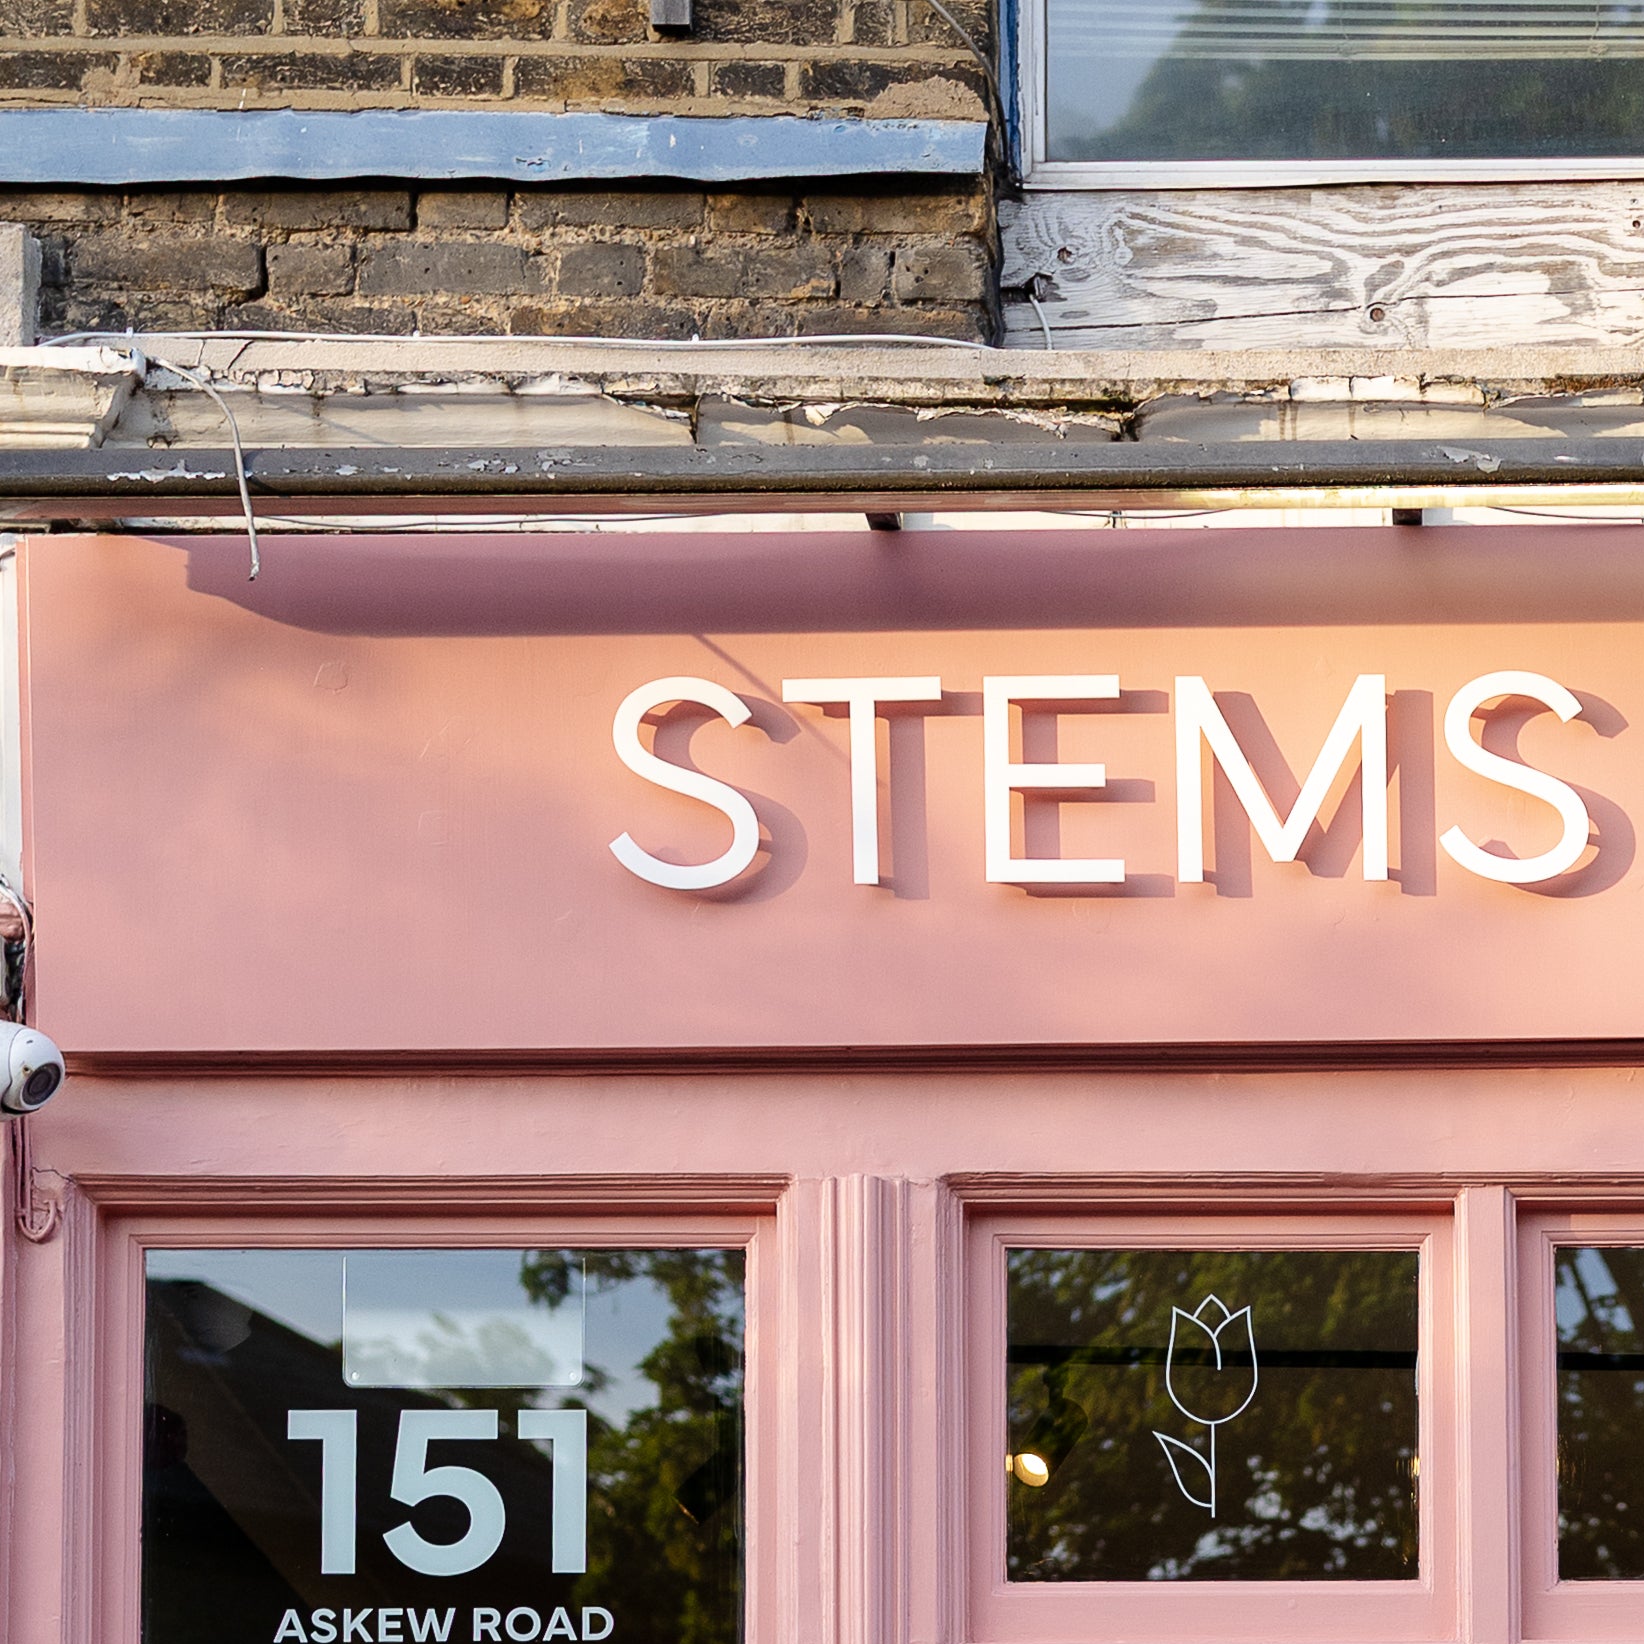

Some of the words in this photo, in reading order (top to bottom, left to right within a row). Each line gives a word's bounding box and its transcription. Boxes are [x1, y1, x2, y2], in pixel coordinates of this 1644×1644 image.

[609, 671, 1588, 889] STEMS
[288, 1409, 587, 1576] 151
[273, 1607, 455, 1643] ASKEW
[472, 1606, 614, 1642] ROAD
